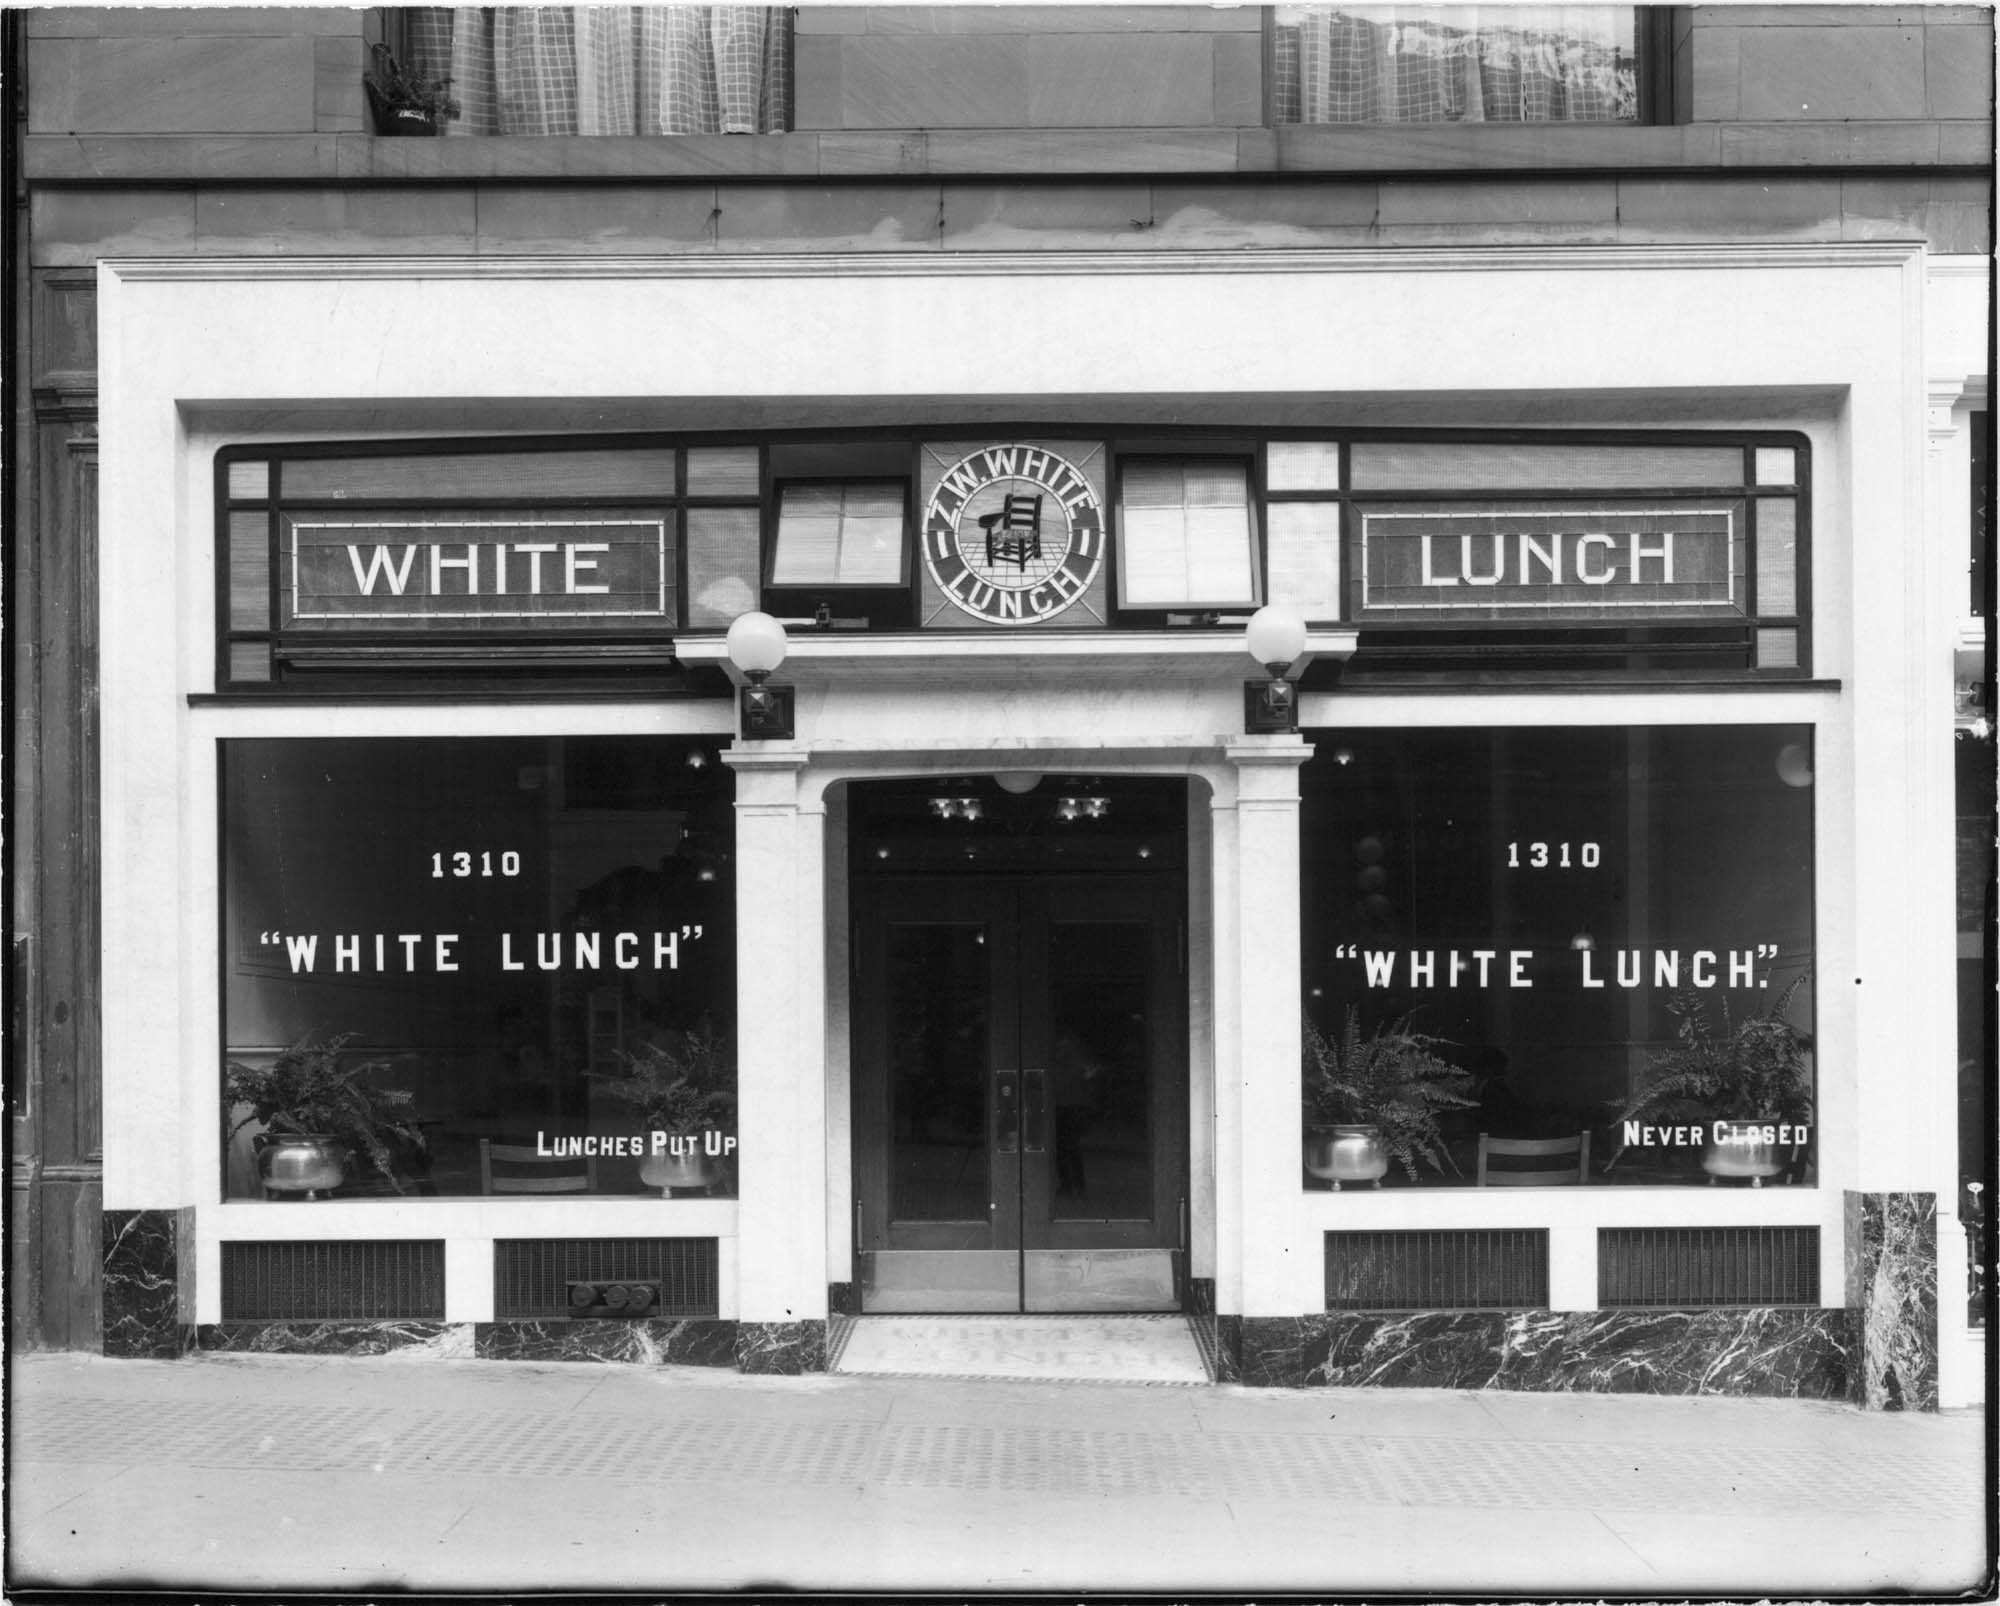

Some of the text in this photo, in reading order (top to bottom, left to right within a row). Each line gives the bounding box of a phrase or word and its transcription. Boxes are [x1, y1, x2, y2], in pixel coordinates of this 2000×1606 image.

[347, 543, 610, 596] WHITE
[1421, 533, 1674, 587] LUNCH
[948, 566, 1083, 618] LUNCH
[432, 851, 520, 878] 1310
[1508, 842, 1600, 868] 1310
